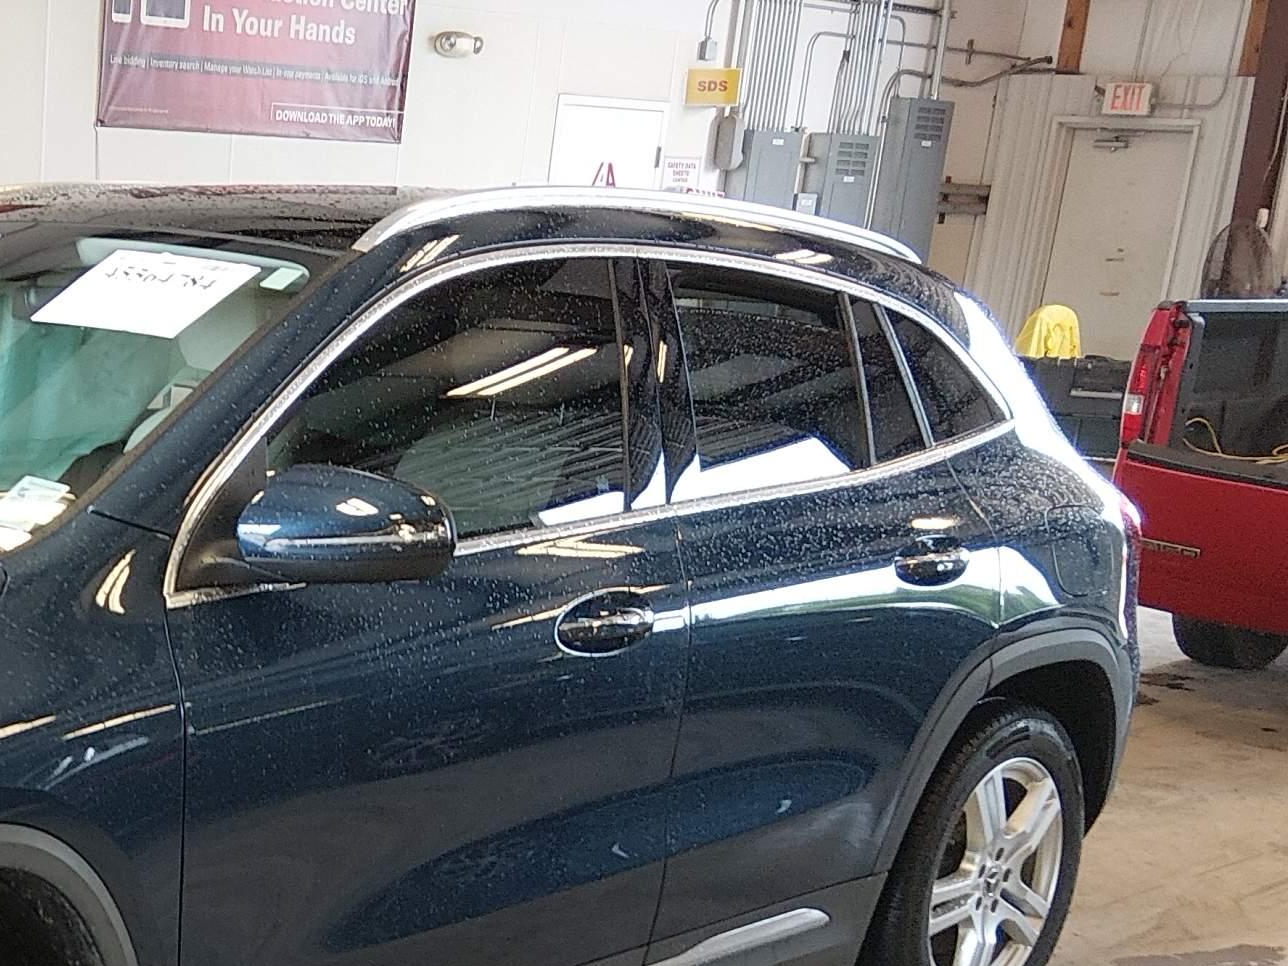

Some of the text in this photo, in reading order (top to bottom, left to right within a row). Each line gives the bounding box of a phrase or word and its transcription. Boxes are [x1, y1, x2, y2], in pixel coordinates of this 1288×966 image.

[202, 5, 357, 45] In Your Hands
[150, 57, 179, 71] Inventory
[179, 59, 200, 70] search
[204, 61, 228, 75] Manage
[697, 79, 729, 93] SDS
[1111, 84, 1145, 112] EXIT
[275, 109, 329, 124] DOWNLOAD
[329, 112, 345, 126] THE
[345, 114, 365, 127] APP
